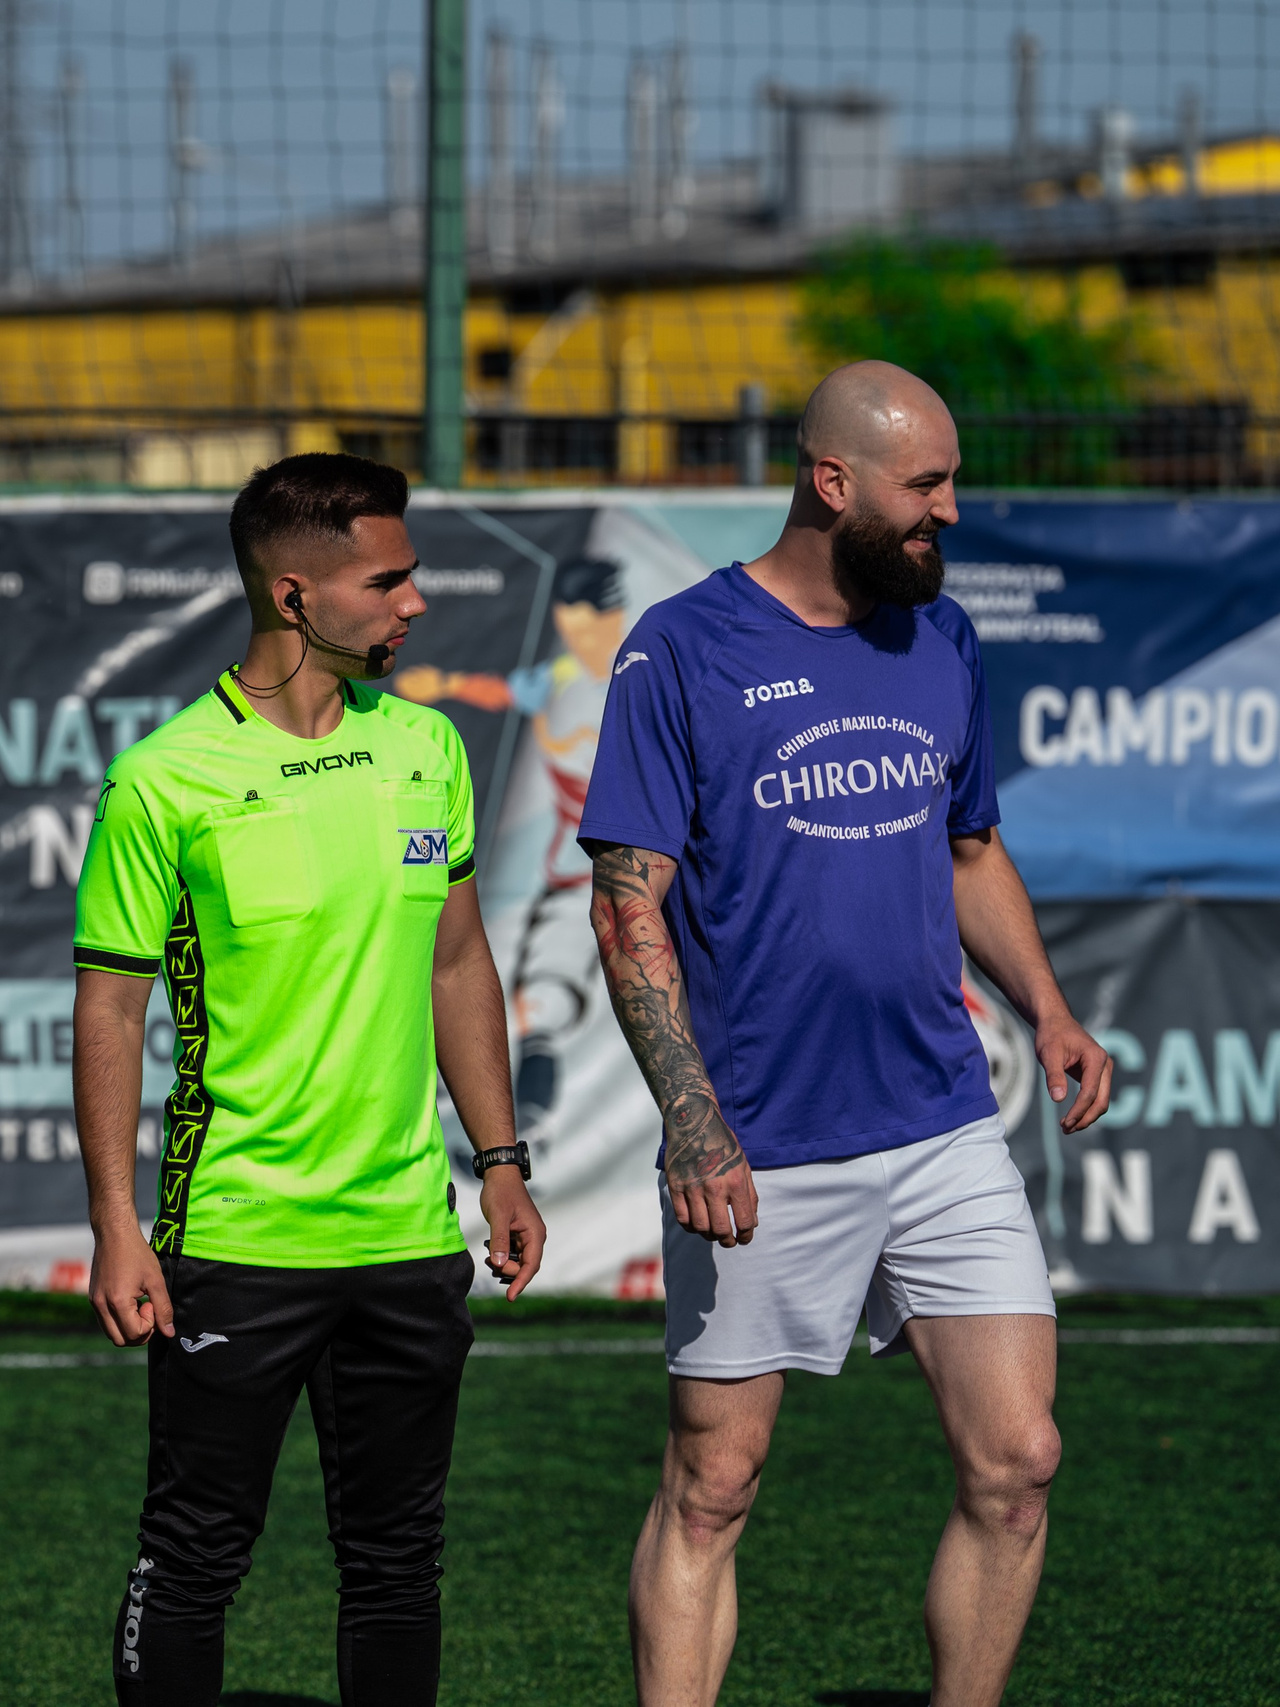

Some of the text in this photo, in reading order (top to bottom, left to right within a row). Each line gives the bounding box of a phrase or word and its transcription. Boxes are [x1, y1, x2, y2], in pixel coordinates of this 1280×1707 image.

[776, 715, 935, 762] CHIRURGIE MAXILO-FACIALA
[280, 751, 374, 778] GIVOVA
[753, 752, 949, 810] CHIROMAX
[786, 815, 871, 841] IMPLANTOLOGIE
